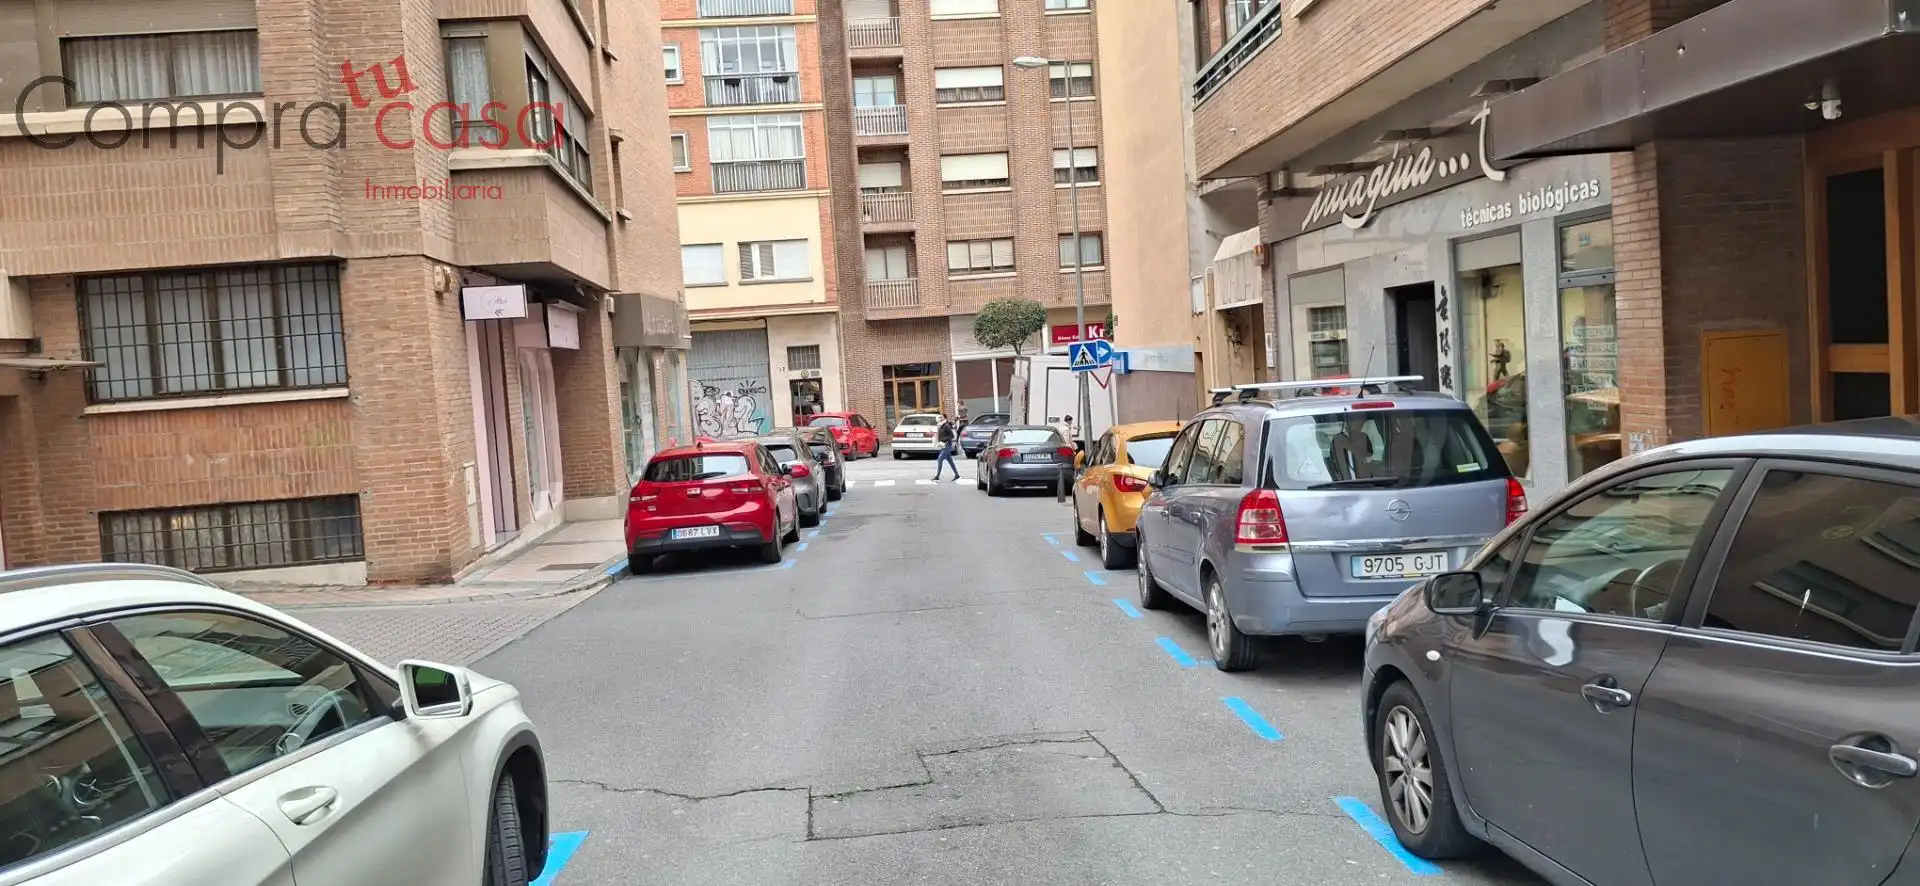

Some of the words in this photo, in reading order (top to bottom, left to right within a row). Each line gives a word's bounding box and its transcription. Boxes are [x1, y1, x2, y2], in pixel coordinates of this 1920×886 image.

[1461, 199, 1512, 228] técnicas
[1519, 176, 1600, 215] biológicas
[1364, 557, 1404, 573] 9705
[1414, 554, 1443, 571] GJT
